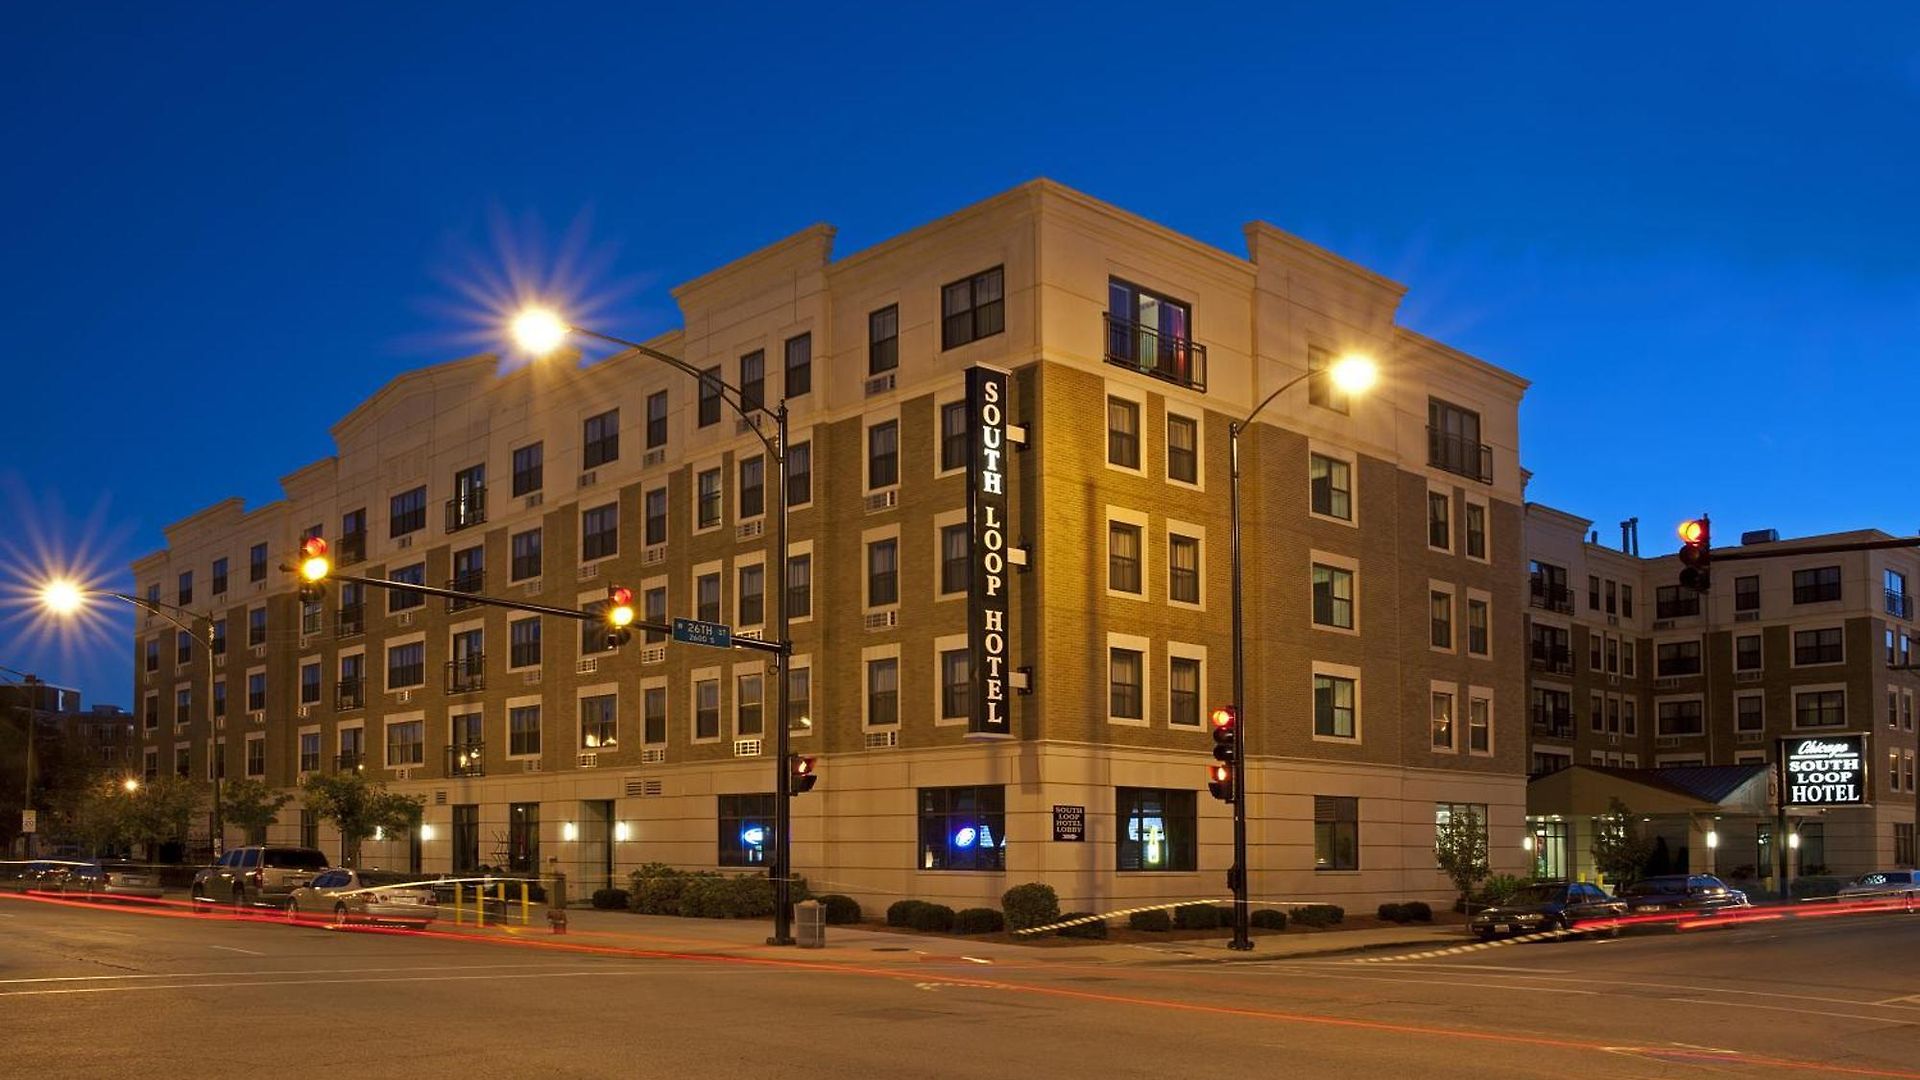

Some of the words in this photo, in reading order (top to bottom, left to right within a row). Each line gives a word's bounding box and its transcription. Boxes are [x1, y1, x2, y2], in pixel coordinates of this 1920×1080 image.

[982, 381, 1002, 494] SOUTH
[984, 506, 1003, 596] LOOP
[687, 623, 713, 636] 26TH
[689, 633, 708, 642] 2600
[984, 610, 1003, 724] HOTEL
[1798, 740, 1849, 758] Chicago
[1789, 759, 1859, 772] SOUTH
[1797, 771, 1853, 784] LOOP
[1791, 784, 1860, 802] HOTEL
[1055, 806, 1083, 814] SOUTH
